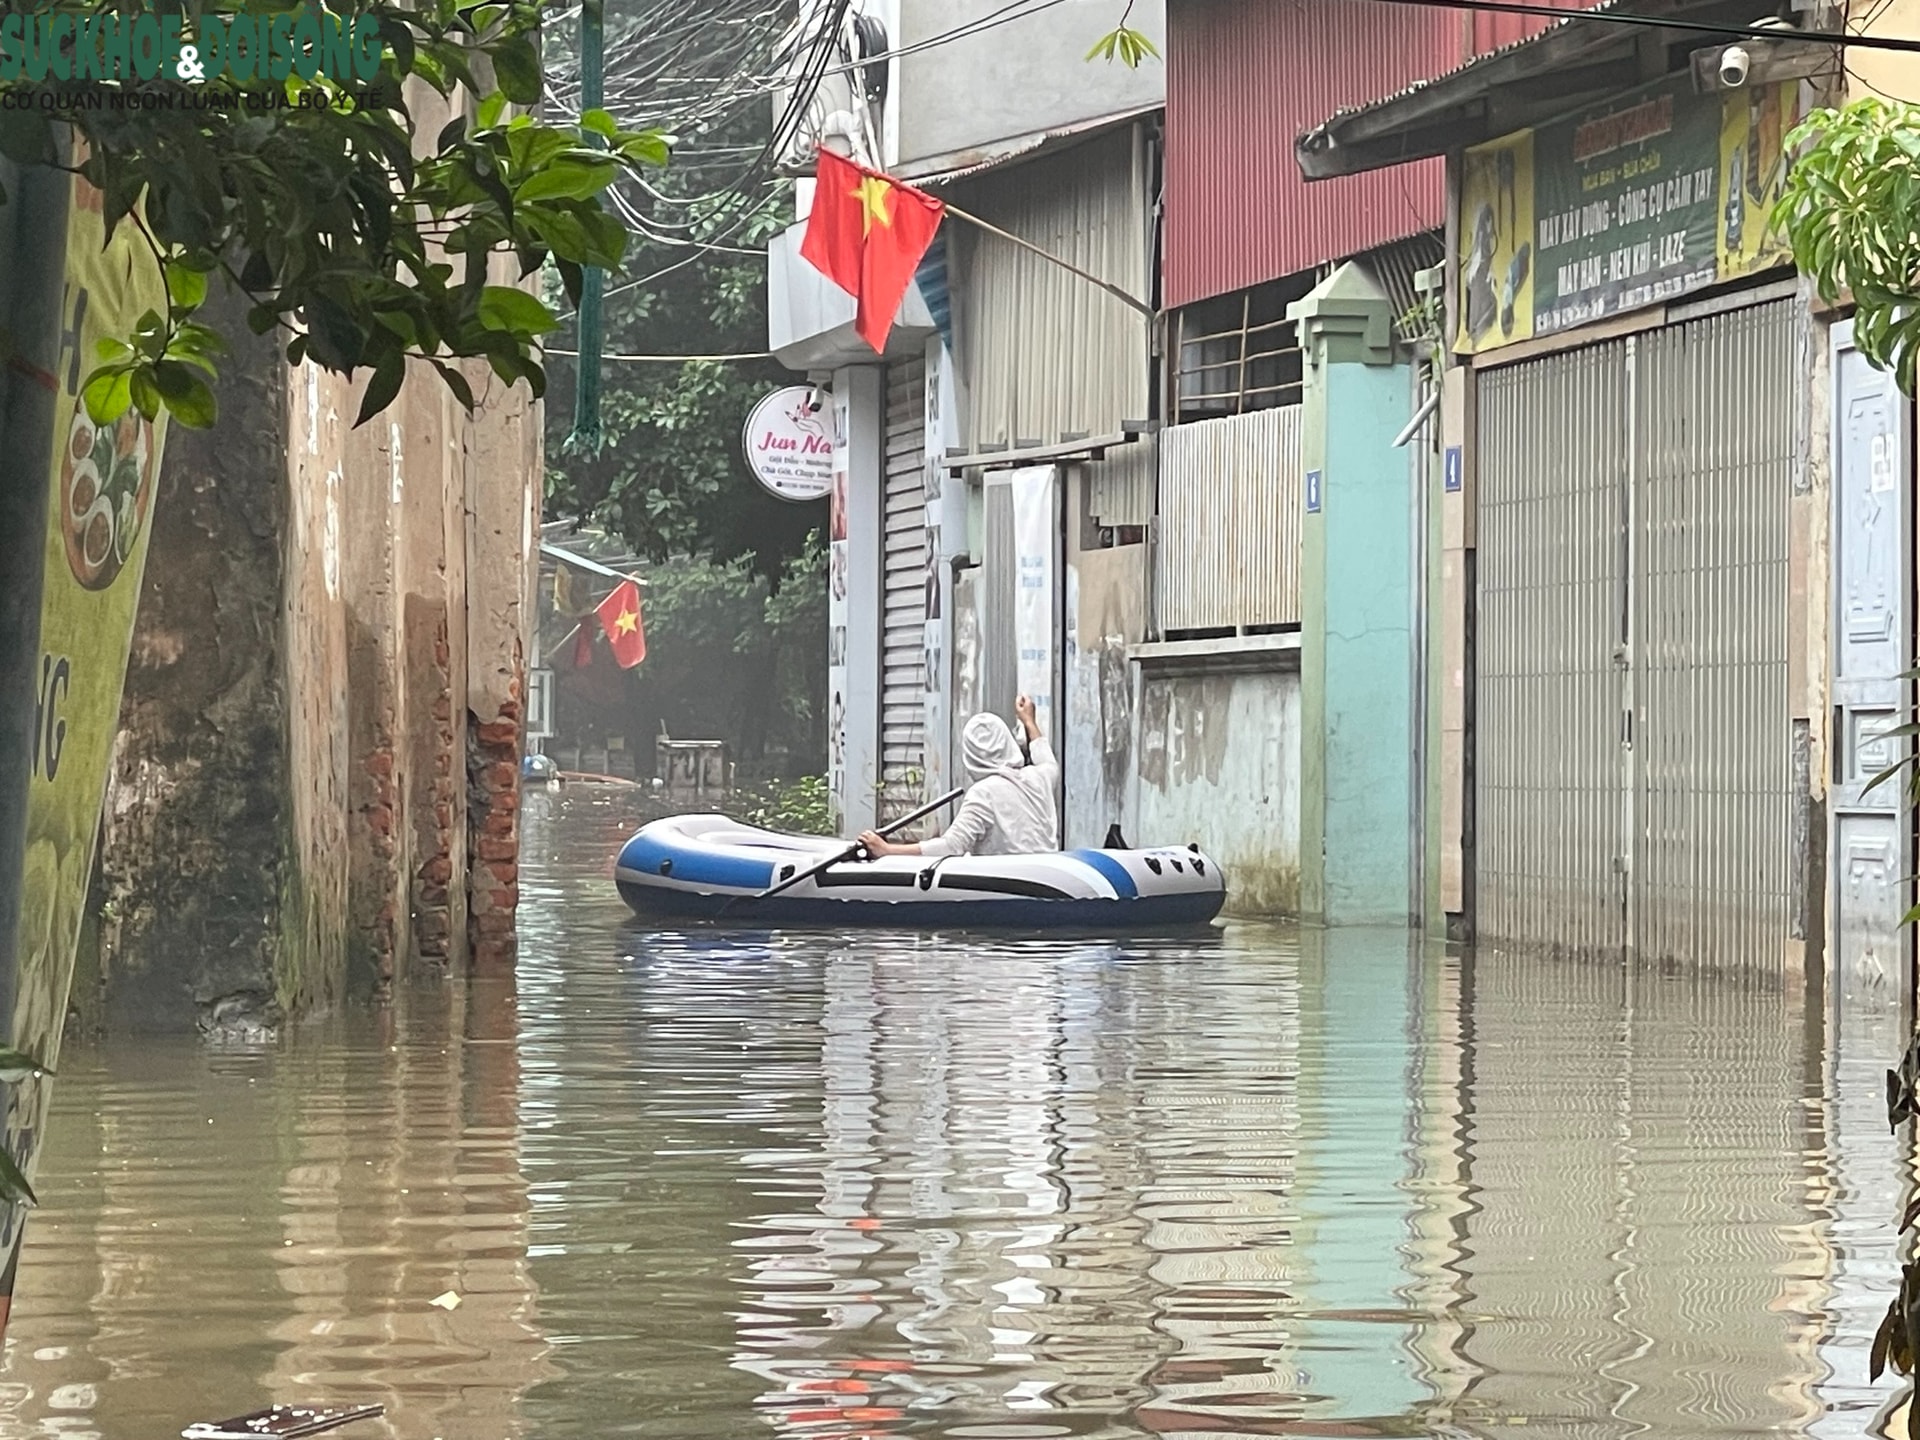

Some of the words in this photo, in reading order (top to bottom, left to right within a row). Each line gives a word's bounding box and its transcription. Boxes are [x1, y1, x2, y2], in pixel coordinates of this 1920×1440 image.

[1561, 204, 1581, 245] XÂY
[1582, 199, 1610, 242] DỰNG
[1618, 186, 1647, 227] CÔNG
[1649, 182, 1665, 223] CỤ
[1666, 165, 1692, 212] CẦM
[1694, 167, 1713, 203] TAY
[1558, 258, 1579, 297] MÁY
[1580, 250, 1601, 291] HÀN
[1609, 243, 1631, 282] NÉN
[1633, 234, 1651, 276] KHÍ
[1659, 230, 1687, 268] LAZE
[1310, 476, 1317, 503] 6
